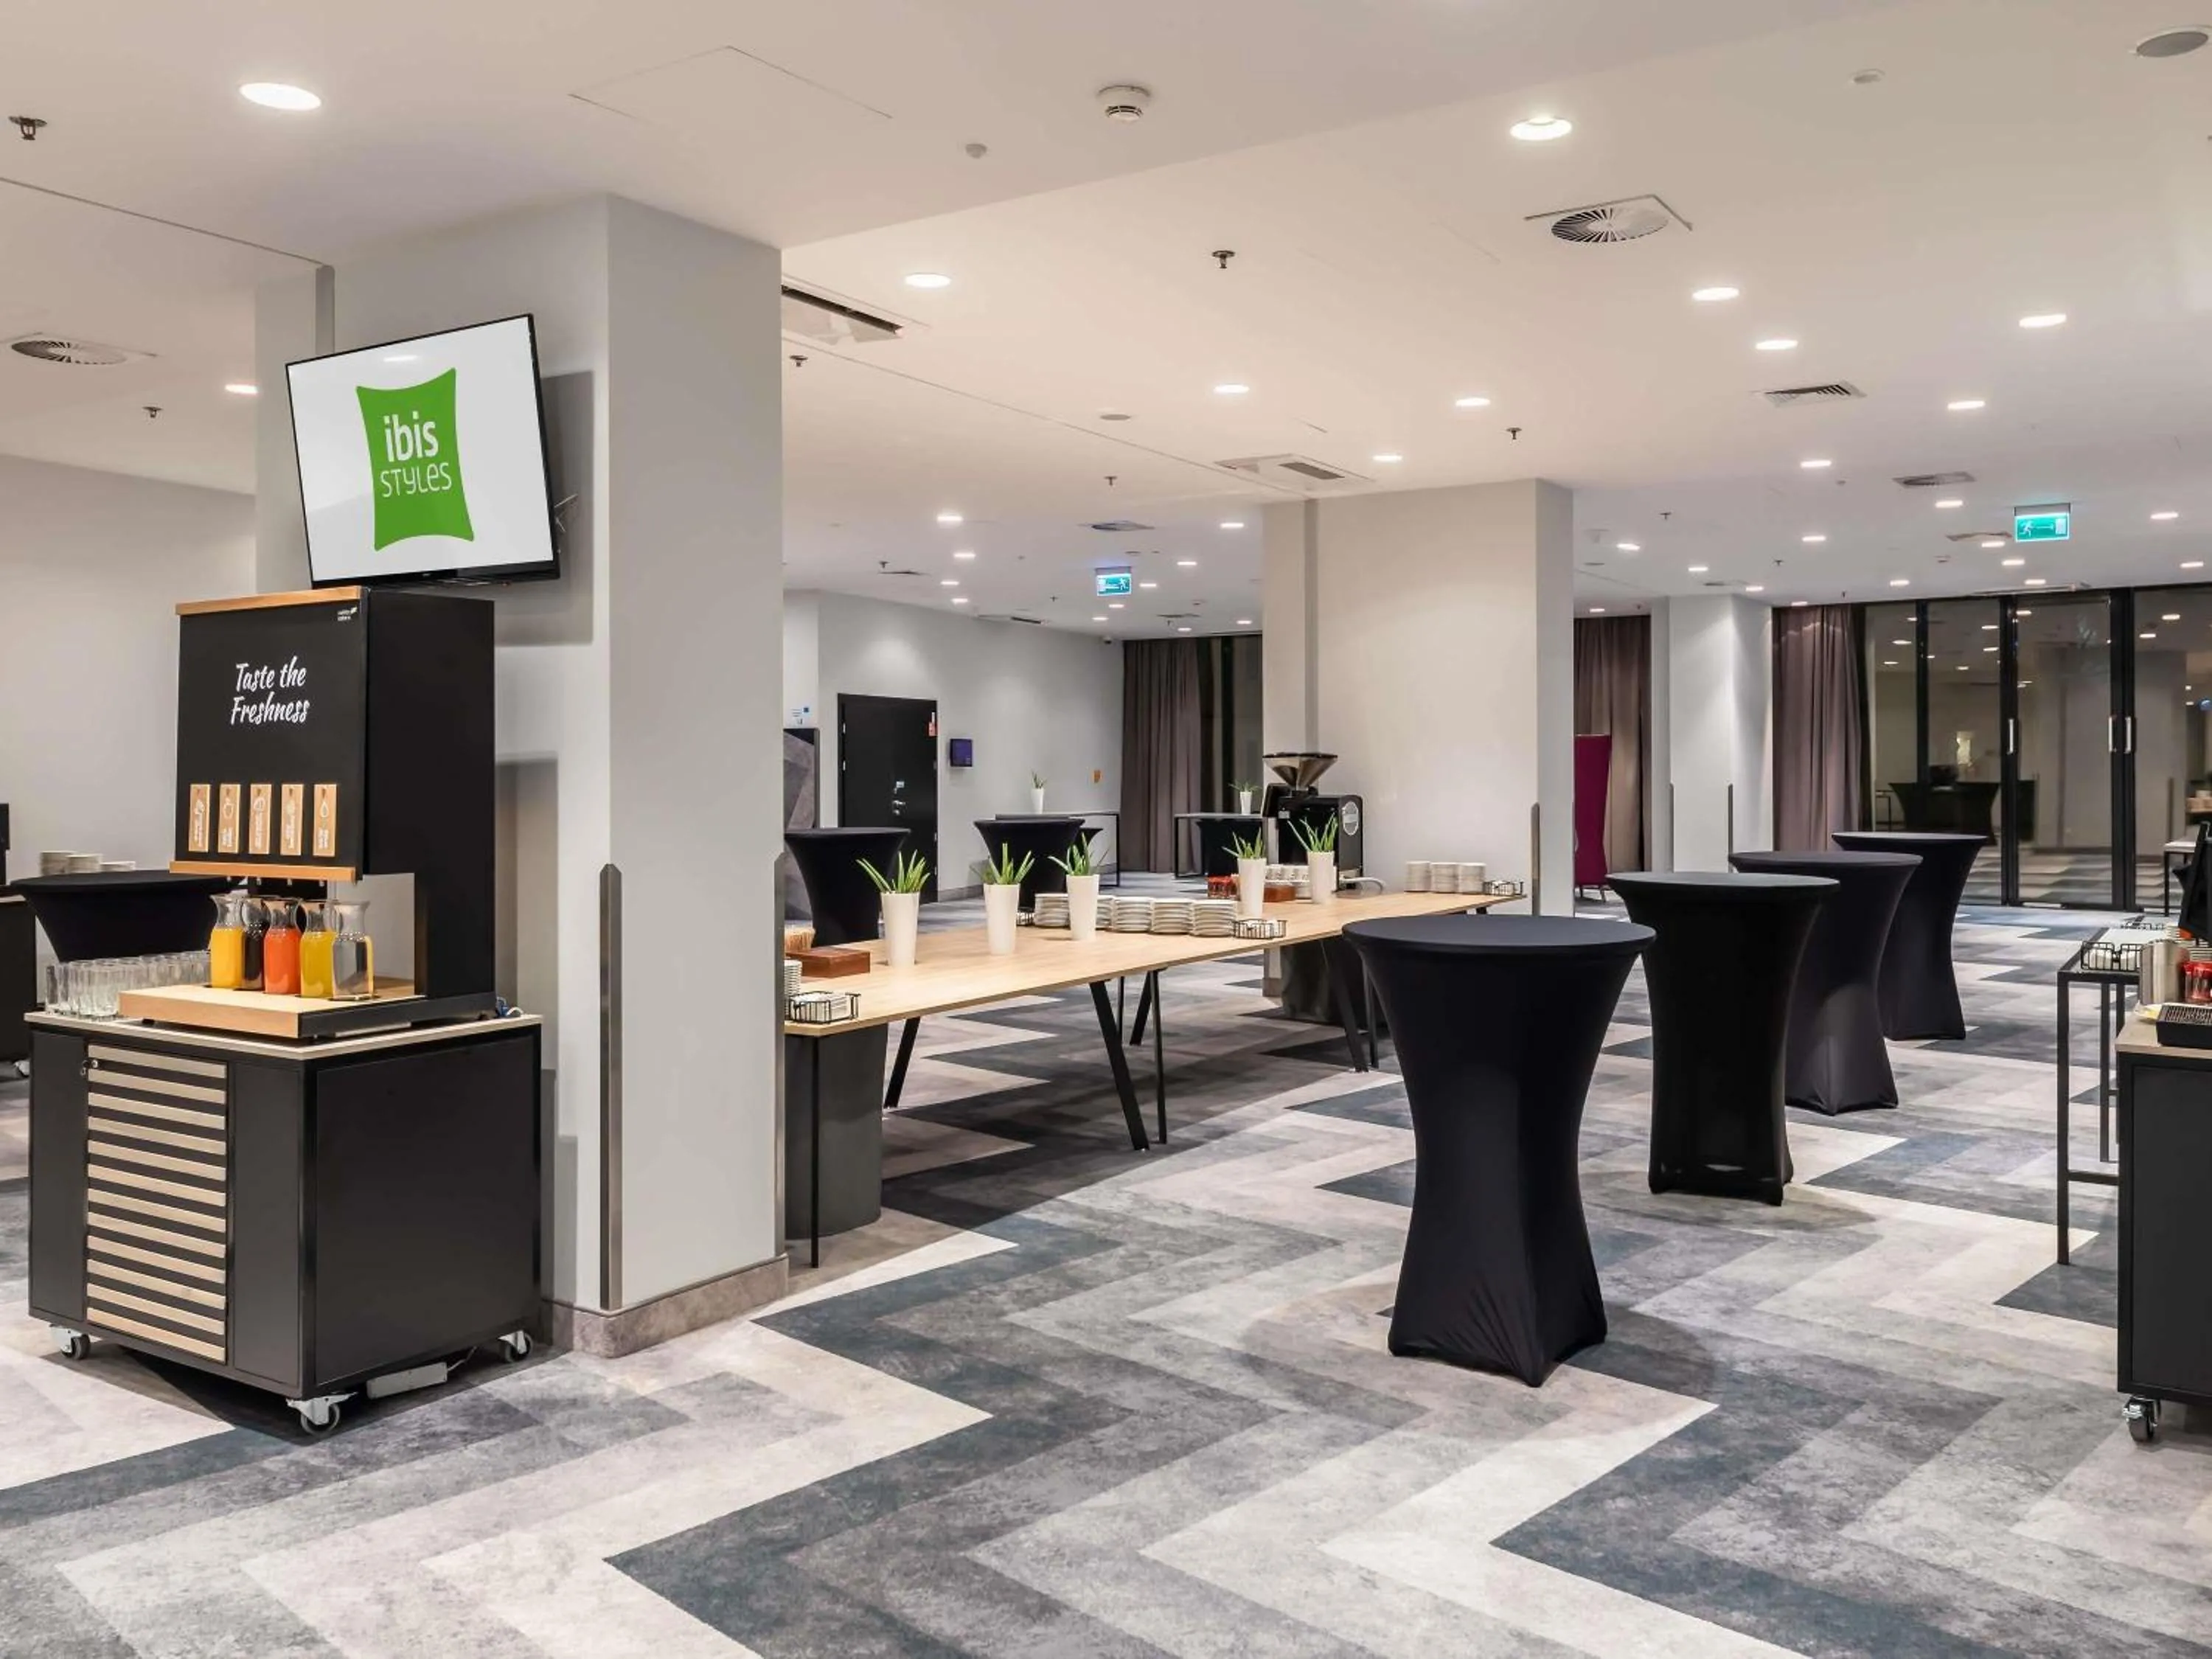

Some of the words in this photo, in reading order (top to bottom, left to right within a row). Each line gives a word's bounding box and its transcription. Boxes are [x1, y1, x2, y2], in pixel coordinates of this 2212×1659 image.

[383, 410, 439, 462] ibis
[236, 662, 275, 692] Taste
[279, 655, 307, 688] the
[231, 691, 310, 725] Freshness
